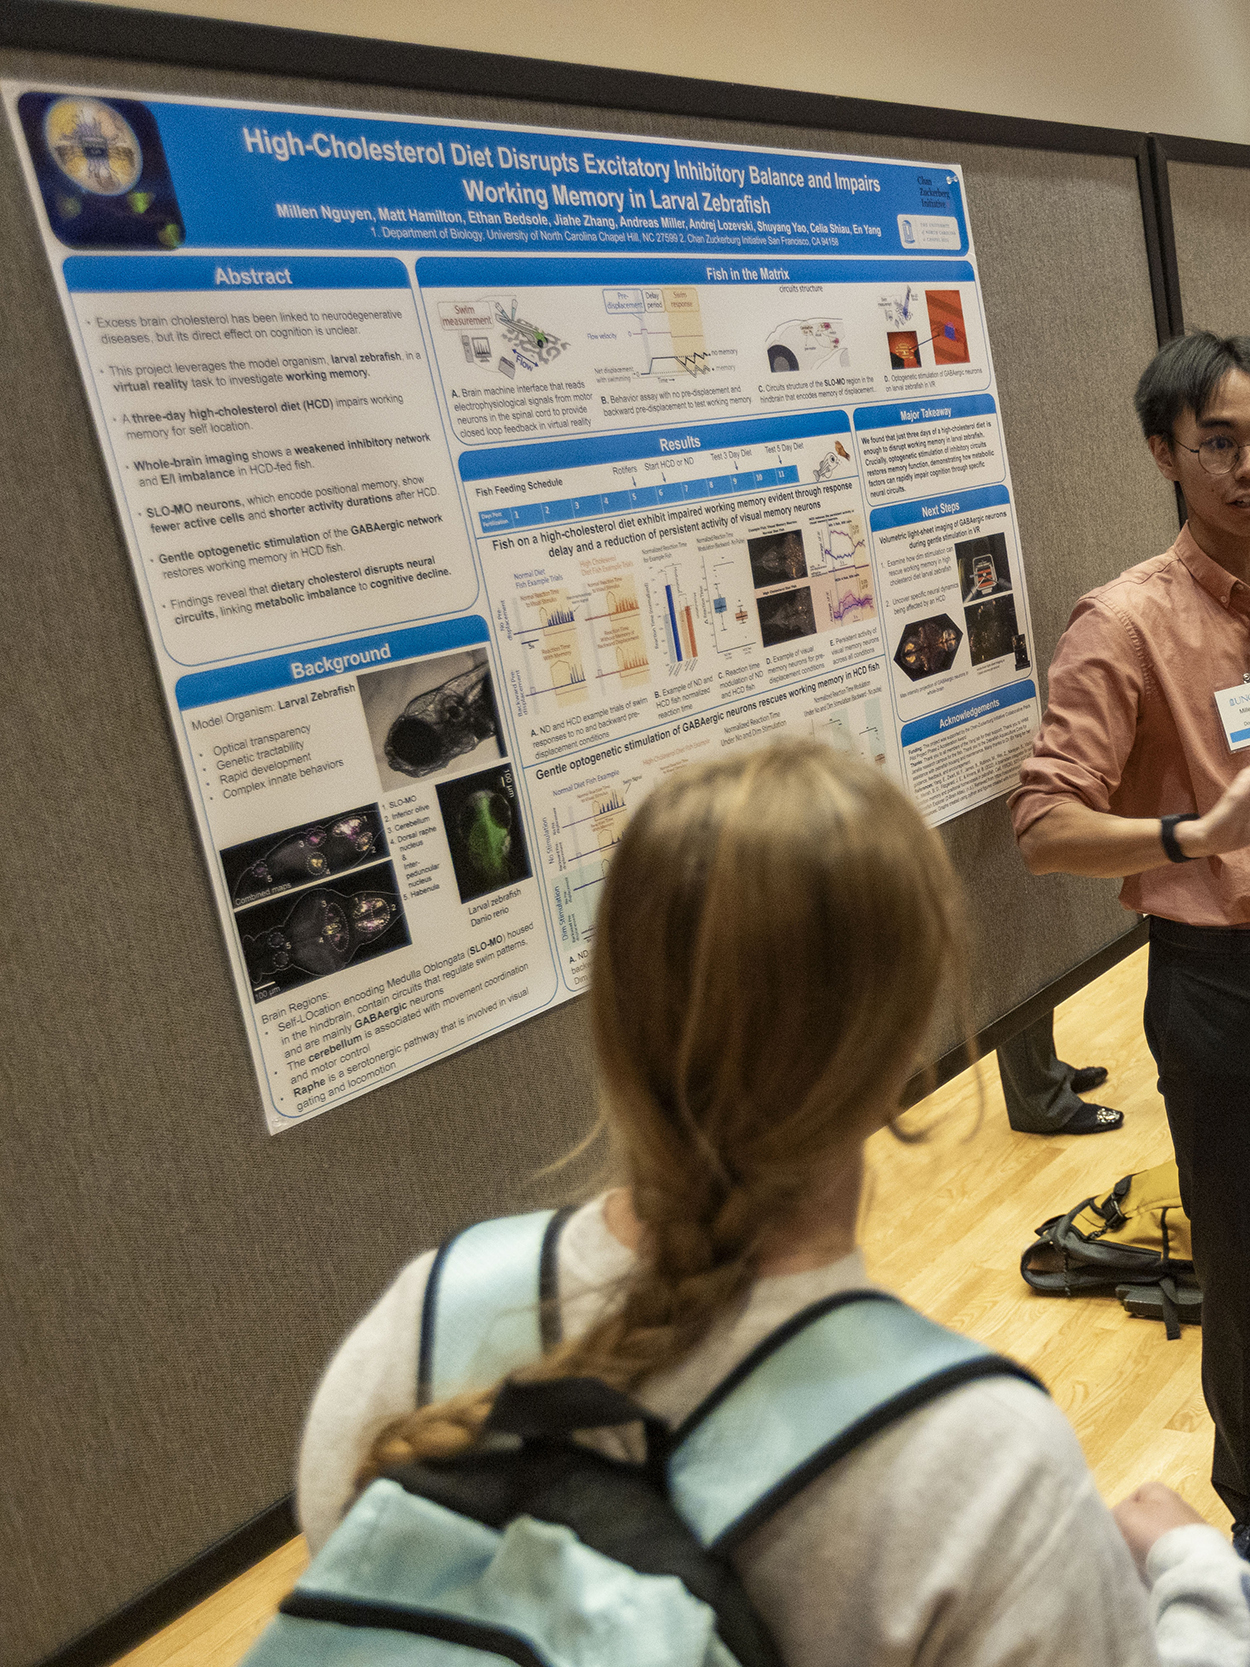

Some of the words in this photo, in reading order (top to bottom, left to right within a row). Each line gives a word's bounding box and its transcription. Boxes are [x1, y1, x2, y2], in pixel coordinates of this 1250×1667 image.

[245, 129, 447, 165] High-Cholesterol
[448, 144, 494, 168] Diet
[495, 147, 580, 177] Disrupts
[581, 153, 673, 184] Excitatory
[673, 160, 747, 188] Inhibitory
[748, 165, 805, 187] Balance
[807, 171, 833, 189] and
[833, 172, 881, 195] Impairs
[917, 176, 932, 185] Chan
[465, 181, 550, 209] Working
[550, 186, 626, 213] Memory
[628, 190, 647, 209] in
[649, 191, 700, 211] Larval
[701, 194, 771, 214] Zebrafish
[276, 205, 318, 218] Millen
[320, 206, 375, 222] Nguyen,
[377, 208, 407, 221] Matt
[408, 209, 465, 224] Hamilton,
[467, 211, 502, 223] Ethan
[503, 212, 550, 226] Bedsole,
[553, 214, 581, 226] Jiahe
[582, 215, 617, 229] Zhang,
[619, 216, 659, 228] Andreas
[661, 217, 687, 230] Miller,
[689, 218, 717, 232] Andrej
[757, 220, 792, 234] Shuyang
[809, 222, 829, 233] Celia
[829, 223, 851, 234] Shiau,
[852, 224, 863, 234] En
[863, 224, 881, 236] Yang
[214, 269, 292, 285] Abstract
[707, 268, 728, 279] Fish
[730, 268, 740, 279] in
[742, 268, 758, 279] the
[760, 269, 789, 280] Matrix
[110, 366, 132, 376] This
[135, 364, 173, 377] project
[175, 363, 227, 373] leverages
[229, 360, 246, 370] the
[249, 358, 280, 369] model
[282, 357, 329, 368] organism,
[331, 354, 358, 364] larval
[360, 352, 404, 363] zebrafish,
[901, 410, 920, 422] Major
[922, 408, 952, 418] Takeaway
[134, 456, 202, 472] Whole-brain
[205, 452, 250, 465] imaging
[252, 449, 283, 460] shows
[286, 449, 292, 457] a
[295, 442, 346, 456] weakened
[348, 439, 394, 451] inhibitory
[396, 434, 430, 446] network
[660, 436, 700, 452] Results
[644, 461, 660, 471] Start
[660, 459, 676, 469] HCD
[475, 486, 493, 497] Fish
[494, 483, 526, 494] Feeding
[528, 478, 563, 490] Schedule
[492, 537, 515, 551] Fish
[517, 537, 530, 547] on
[532, 535, 538, 544] a
[540, 520, 616, 544] high-cholesterol
[618, 517, 636, 529] diet
[637, 512, 666, 526] exhibit
[667, 506, 703, 522] impaired
[705, 502, 736, 515] working
[737, 497, 767, 509] memory
[768, 491, 794, 504] evident
[795, 486, 822, 499] through
[823, 483, 853, 495] response
[922, 505, 939, 517] Next
[940, 503, 959, 514] Steps
[290, 643, 392, 679] Background
[191, 713, 223, 730] Model
[225, 704, 276, 723] Organism:
[277, 694, 309, 710] Larval
[310, 683, 356, 703] Zebrafish
[535, 762, 567, 780] Gentle
[569, 744, 622, 770] optogenetic
[624, 729, 671, 751] stimulation
[672, 724, 681, 736] of
[682, 712, 724, 733] GABAergic
[726, 702, 757, 719] neurons
[759, 693, 787, 708] rescues
[789, 683, 817, 699] working
[818, 675, 845, 689] memory
[845, 672, 852, 681] in
[853, 666, 867, 678] HCD
[868, 662, 880, 673] fish
[940, 700, 999, 728] Acknowledgements
[213, 738, 248, 756] Optical
[249, 726, 312, 747] transparency
[216, 753, 255, 771] Genetic
[256, 742, 305, 761] tractability
[219, 768, 249, 785] Rapid
[250, 752, 311, 777] development
[222, 780, 266, 799] Complex
[267, 771, 298, 787] innate
[299, 760, 344, 779] behaviors
[468, 898, 490, 915] Larval
[490, 887, 521, 907] zebrafish
[261, 1007, 287, 1025] Brain
[288, 992, 331, 1014] Regions:
